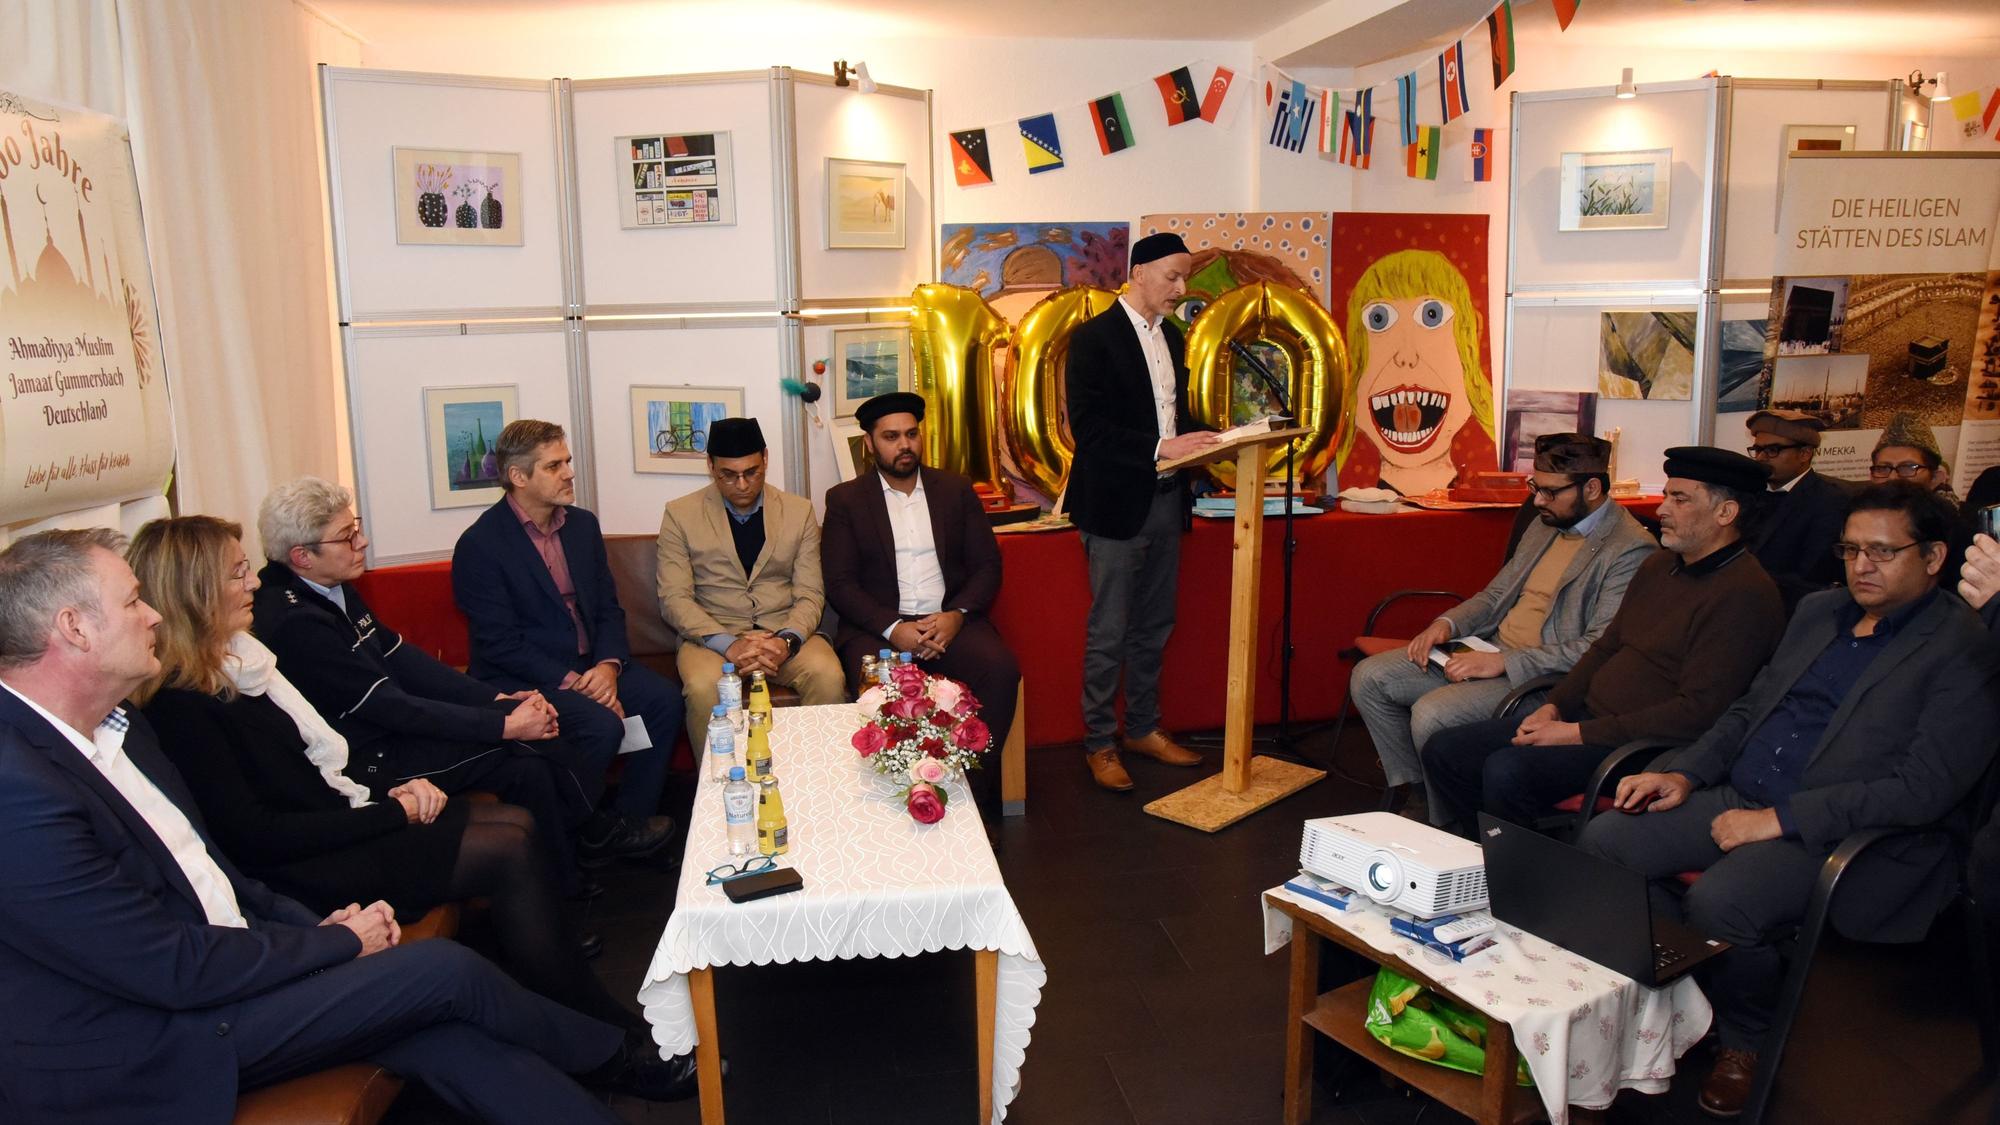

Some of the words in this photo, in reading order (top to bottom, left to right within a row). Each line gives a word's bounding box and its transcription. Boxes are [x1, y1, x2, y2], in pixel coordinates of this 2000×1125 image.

[21, 119, 92, 203] Jahre
[1831, 198, 1865, 218] DIE
[1868, 198, 1961, 218] HEILIGEN
[1796, 225, 1882, 249] STÄTTEN
[1886, 228, 1923, 247] DES
[1926, 227, 1987, 247] ISLAM
[8, 336, 75, 363] Ahmadiyya
[75, 332, 114, 357] Muslim
[9, 372, 54, 400] Jamaat
[55, 366, 124, 397] Gummersbach
[43, 399, 108, 426] Deutschland
[1823, 446, 1856, 456] MEKKA
